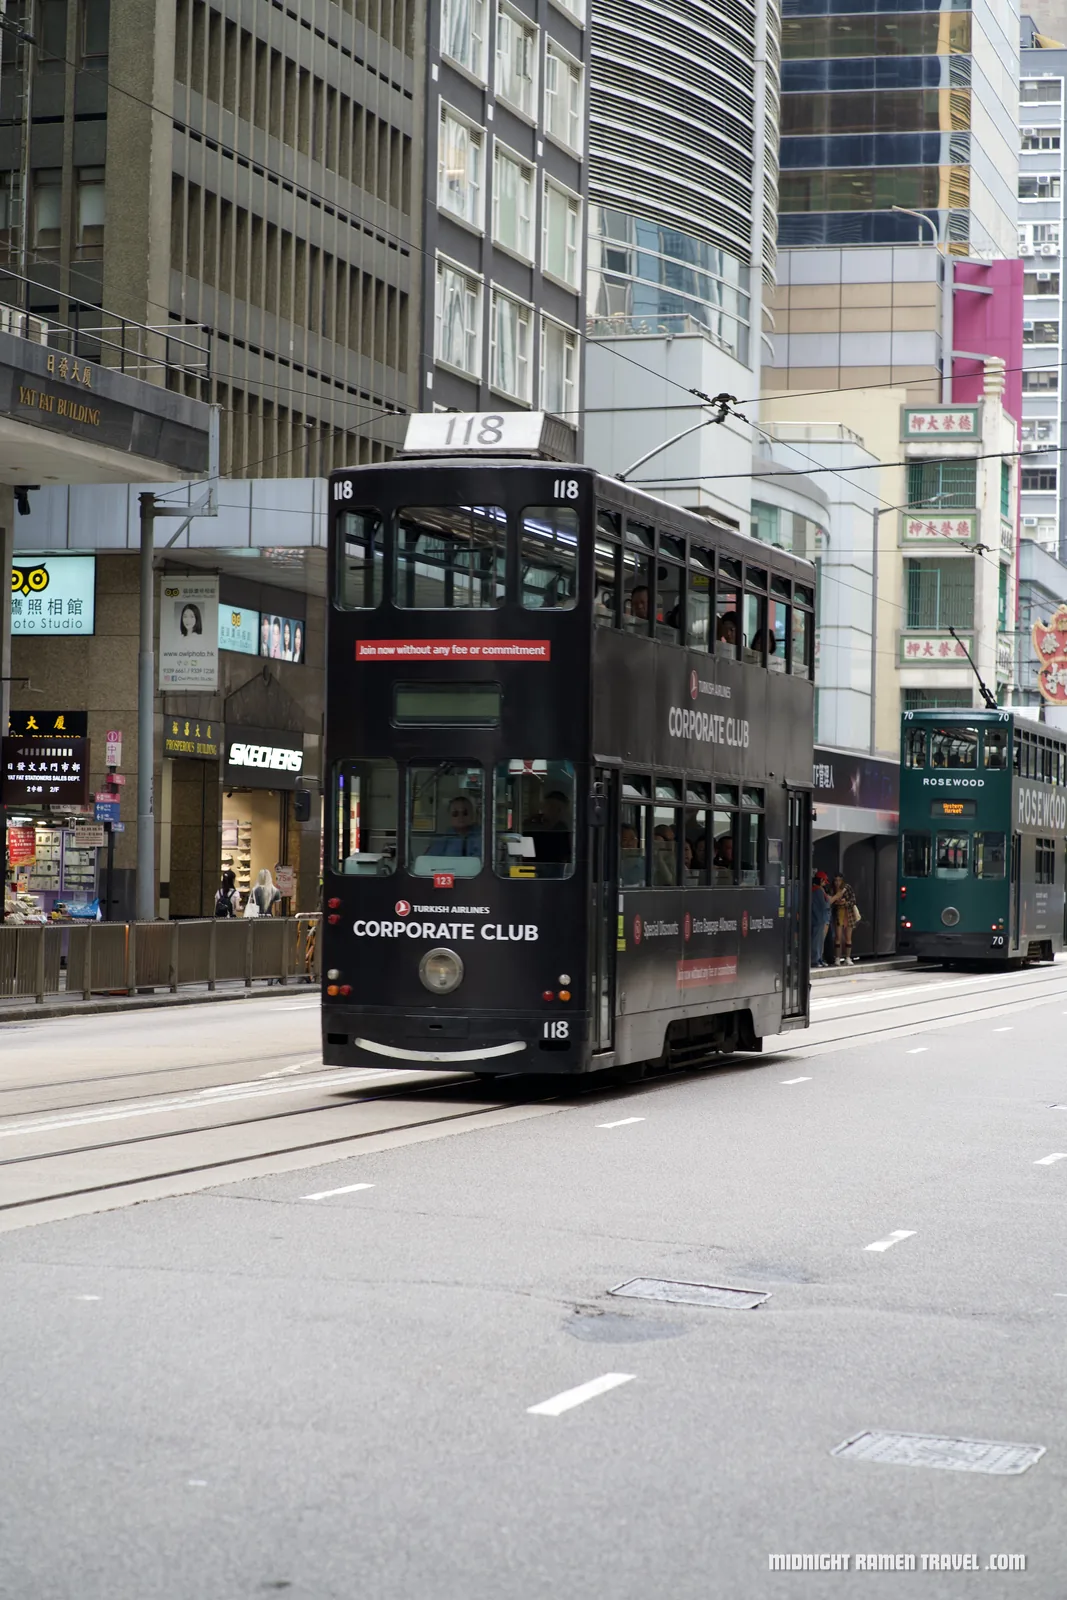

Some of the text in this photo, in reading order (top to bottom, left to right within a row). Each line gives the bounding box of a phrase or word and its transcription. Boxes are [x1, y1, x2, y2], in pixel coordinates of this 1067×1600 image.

[20, 386, 101, 426] YAT FAT BUILDING
[443, 415, 505, 445] 118
[334, 481, 353, 500] 118
[553, 479, 579, 499] 118
[41, 617, 83, 629] Studio
[359, 644, 546, 657] Join now without any fee or commitment
[904, 711, 914, 720] 70
[999, 713, 1010, 721] 70
[669, 706, 749, 748] CORPORATE CLUB
[229, 743, 303, 771] SKECHERS
[923, 778, 985, 787] ROSEWOOD
[1018, 788, 1066, 829] ROSEWOOD
[435, 876, 452, 886] 123
[413, 905, 490, 914] TURKISH AIRLINES
[353, 920, 539, 941] CORPORATE CLUB
[992, 936, 1004, 945] 70
[543, 1020, 569, 1039] 118
